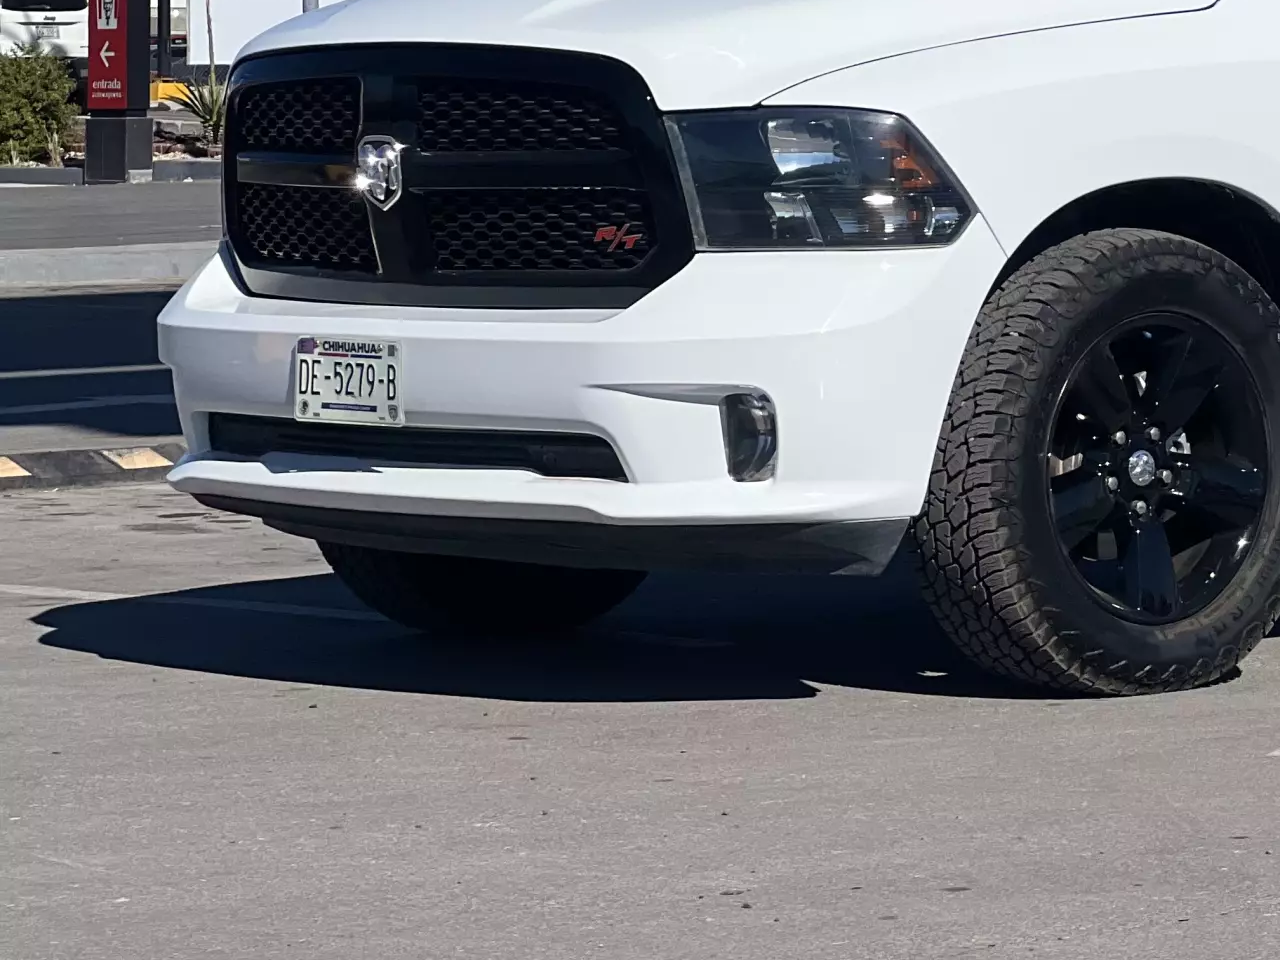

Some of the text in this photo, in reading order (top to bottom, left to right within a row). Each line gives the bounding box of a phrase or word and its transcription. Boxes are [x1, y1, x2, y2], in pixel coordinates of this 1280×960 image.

[92, 78, 121, 89] entrada
[593, 223, 643, 252] R/T
[322, 341, 379, 354] CHIHUAHUA
[299, 359, 396, 400] DE-5279-B
